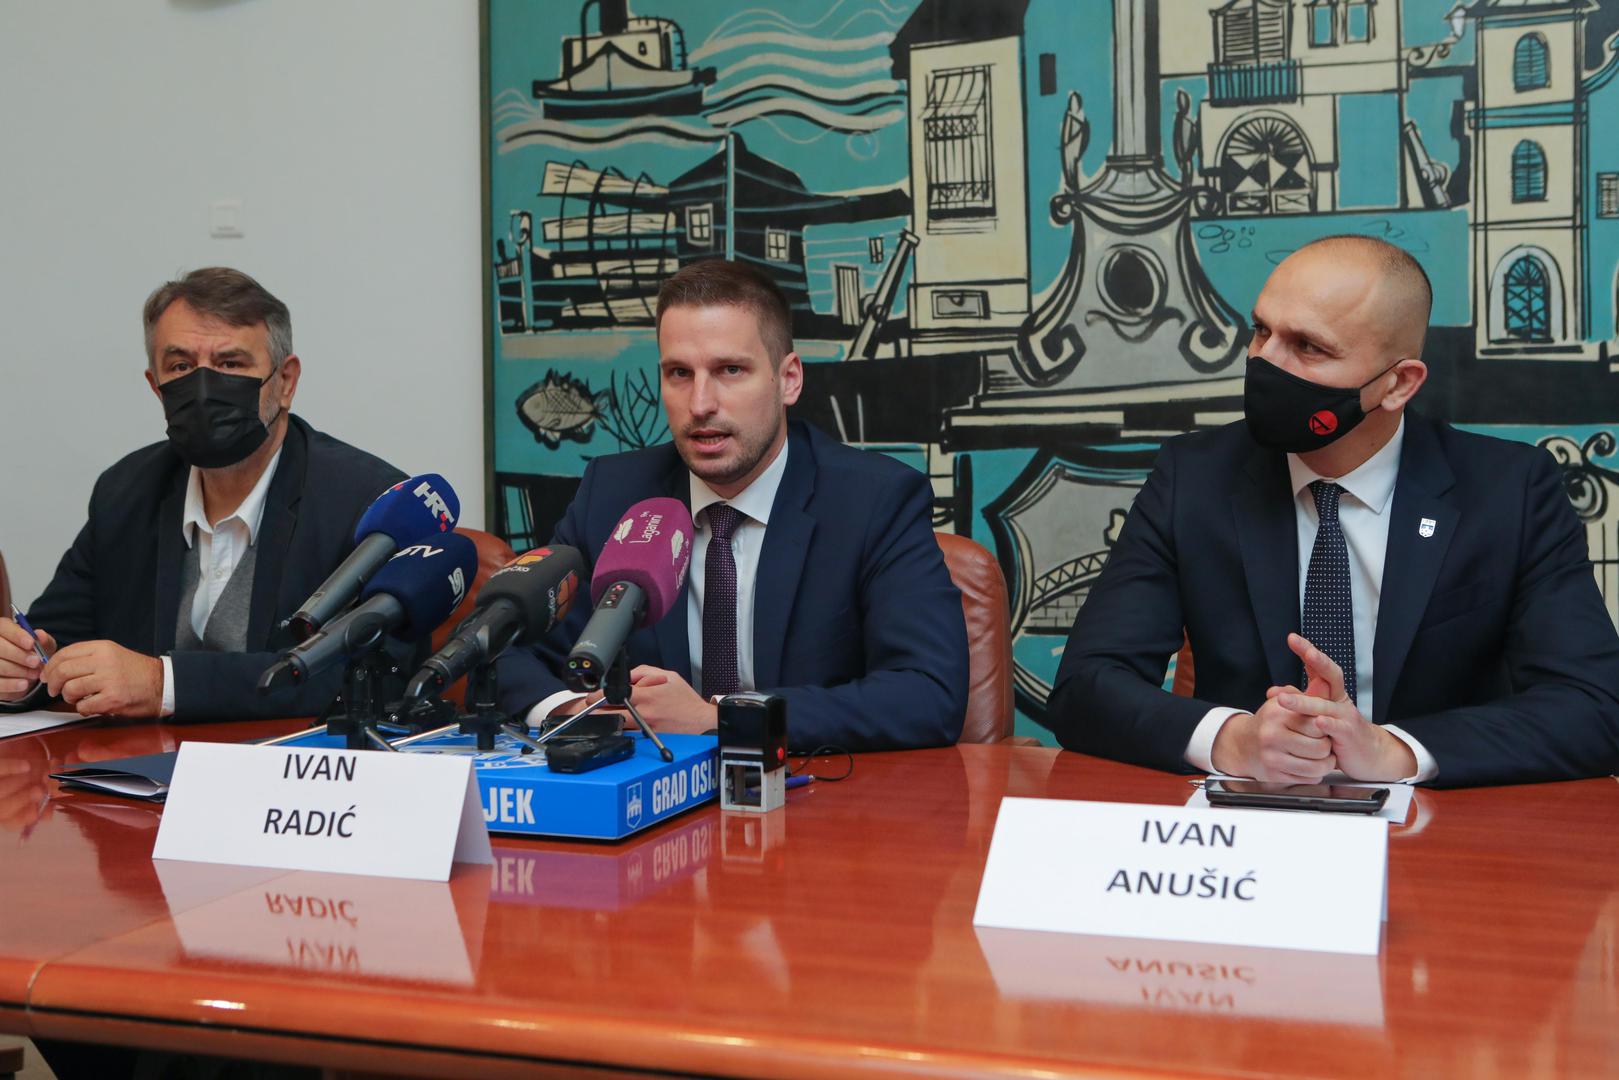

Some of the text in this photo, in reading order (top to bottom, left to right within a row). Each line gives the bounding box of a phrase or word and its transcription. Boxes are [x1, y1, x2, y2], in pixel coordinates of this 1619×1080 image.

[413, 481, 455, 523] HRT
[283, 753, 357, 782] IVAN
[483, 787, 535, 824] JEK
[652, 769, 687, 815] GRAD
[263, 804, 356, 838] RADIĆ
[1141, 820, 1236, 848] IVAN
[1106, 866, 1258, 901] ANUŠIĆ
